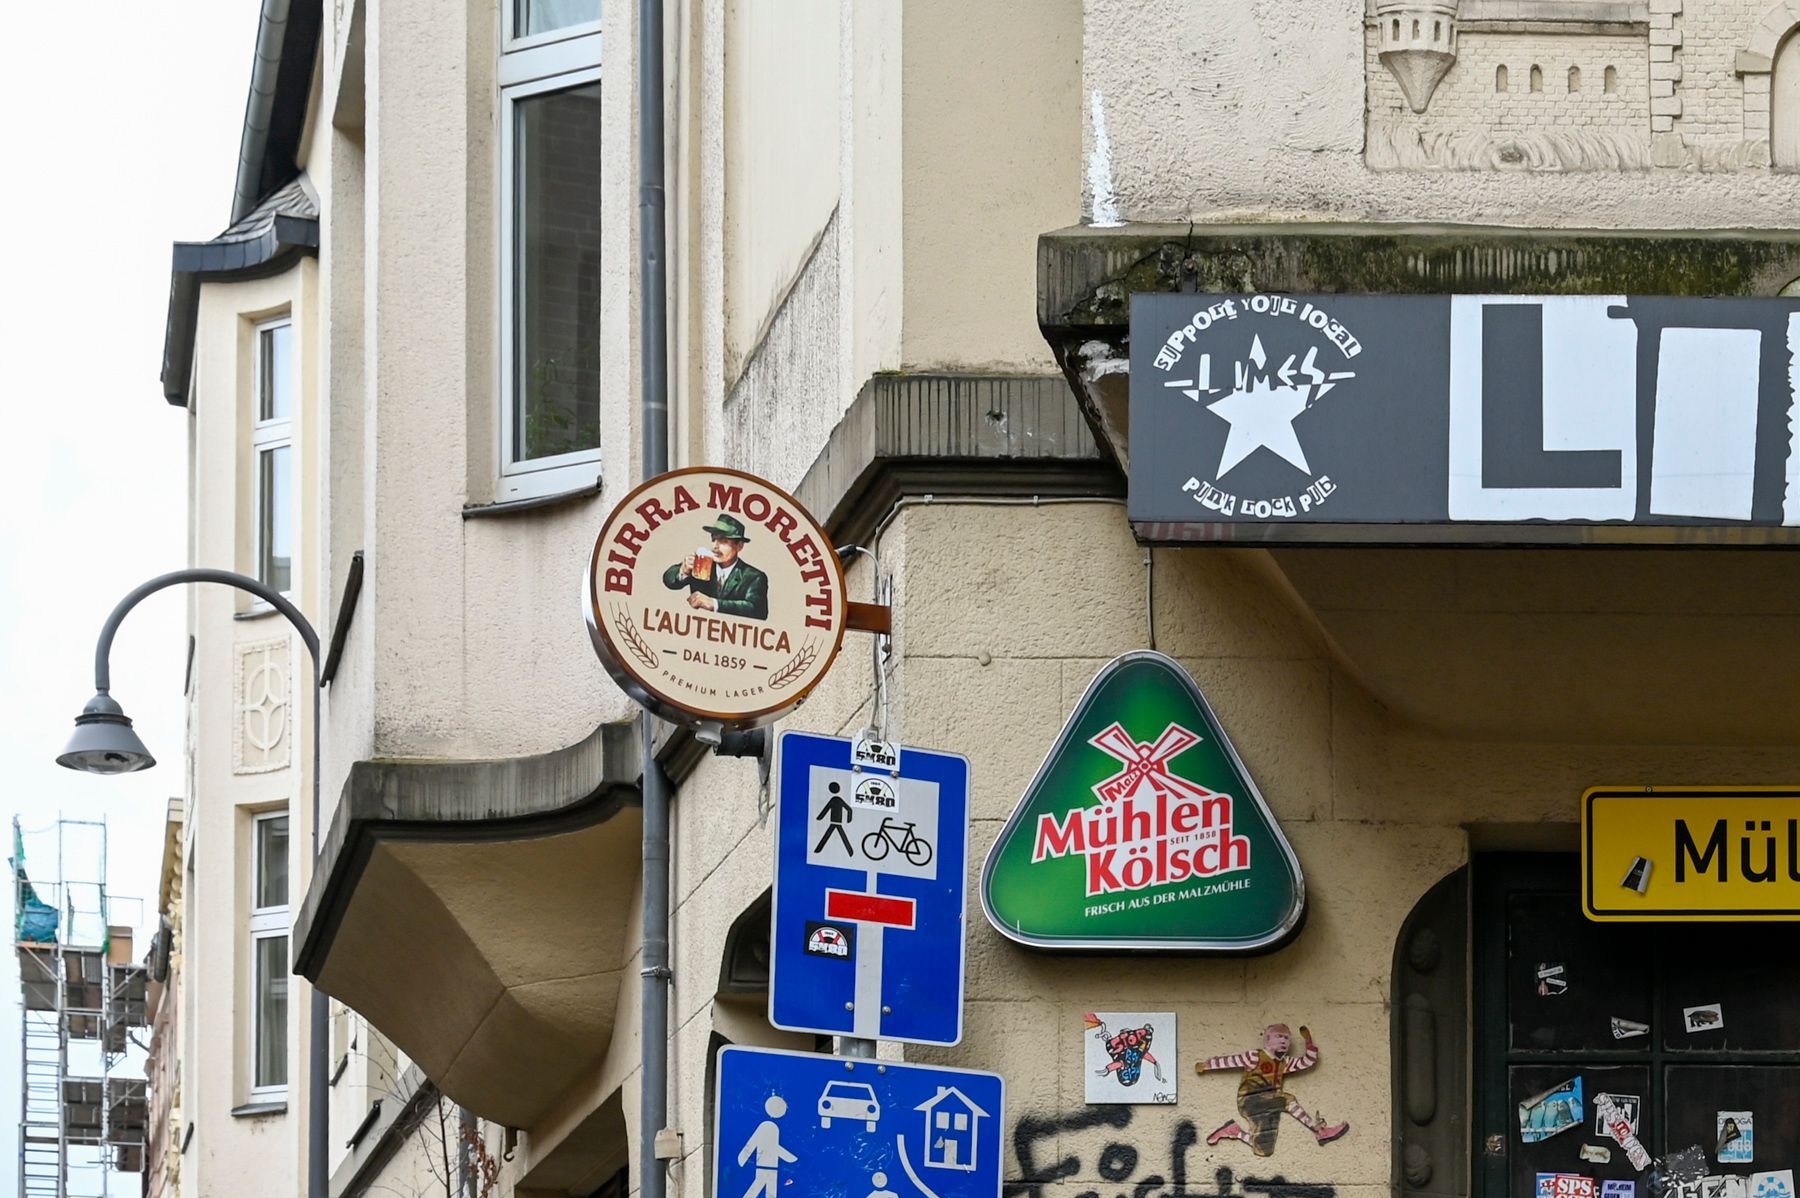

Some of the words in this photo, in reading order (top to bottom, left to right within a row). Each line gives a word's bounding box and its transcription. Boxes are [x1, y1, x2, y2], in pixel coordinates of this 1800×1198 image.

[1198, 346, 1326, 408] LIMES
[604, 485, 700, 596] BIRRA
[707, 481, 832, 632] MORETTI
[643, 607, 791, 654] L'AUTENTICA
[683, 649, 710, 666] DAL
[714, 654, 747, 670] 1859
[662, 670, 718, 697] PREMIUM
[725, 686, 765, 698] LAGER
[1105, 770, 1141, 802] Malz
[1036, 794, 1231, 859] Mühlen
[1170, 834, 1191, 846] SEIT
[1194, 829, 1217, 842] 1858
[1088, 829, 1248, 893] Kölsch
[1085, 901, 1126, 918] FRISCH
[1128, 896, 1151, 910] AUS
[1153, 891, 1176, 906] DER
[1178, 878, 1251, 901] MALZMÜHLE
[1556, 1177, 1593, 1195] SPS
